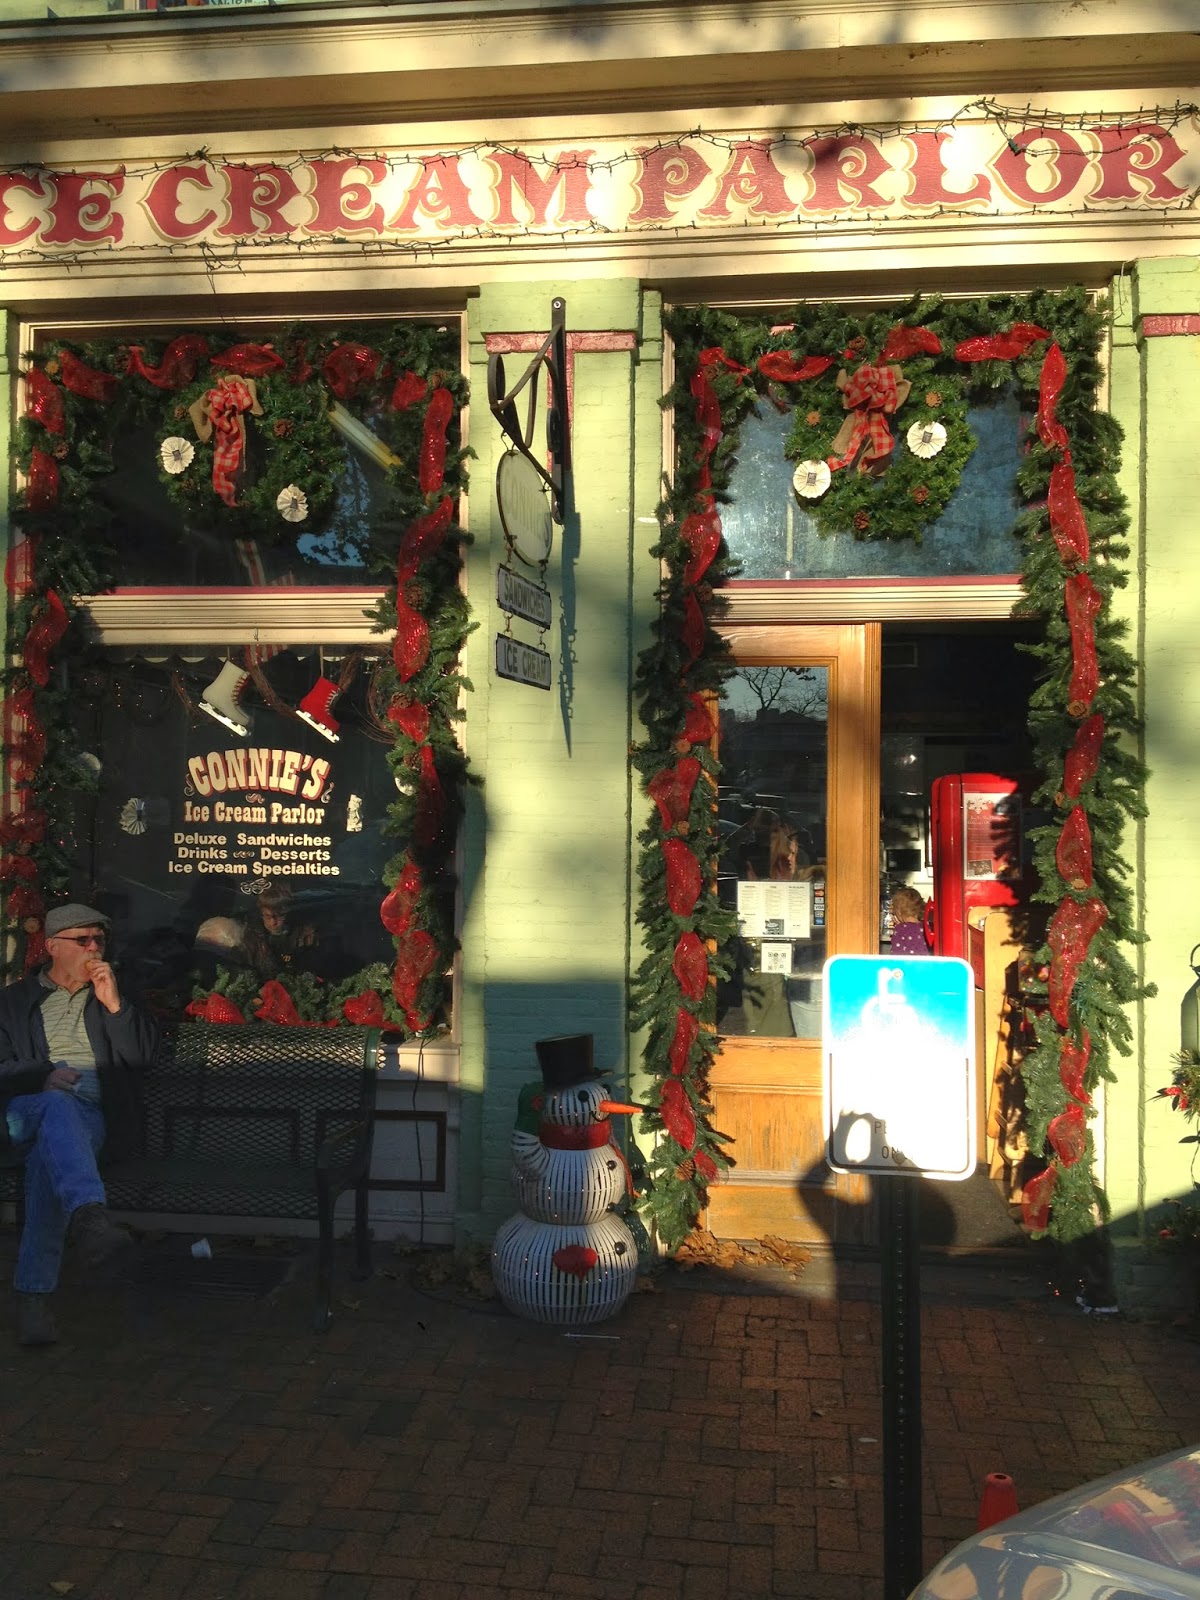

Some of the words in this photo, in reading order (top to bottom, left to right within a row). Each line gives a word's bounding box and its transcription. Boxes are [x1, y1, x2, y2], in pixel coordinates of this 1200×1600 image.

[138, 150, 597, 242] CREAM
[628, 125, 1190, 223] PARLOR
[504, 573, 545, 618] SANDWICHES
[504, 643, 518, 673] ICE
[522, 650, 546, 681] CREAM
[188, 748, 331, 801] CONNIE'S
[184, 801, 210, 823] Ice
[215, 802, 267, 824] Cream
[270, 802, 325, 825] Parlor
[174, 832, 227, 845] Deluxe
[237, 833, 332, 846] Sandwiches
[177, 847, 228, 859] Drinks
[260, 848, 331, 861] Desserts
[168, 861, 193, 873] Ice
[197, 861, 248, 874] Cream
[252, 862, 340, 877] Specialties
